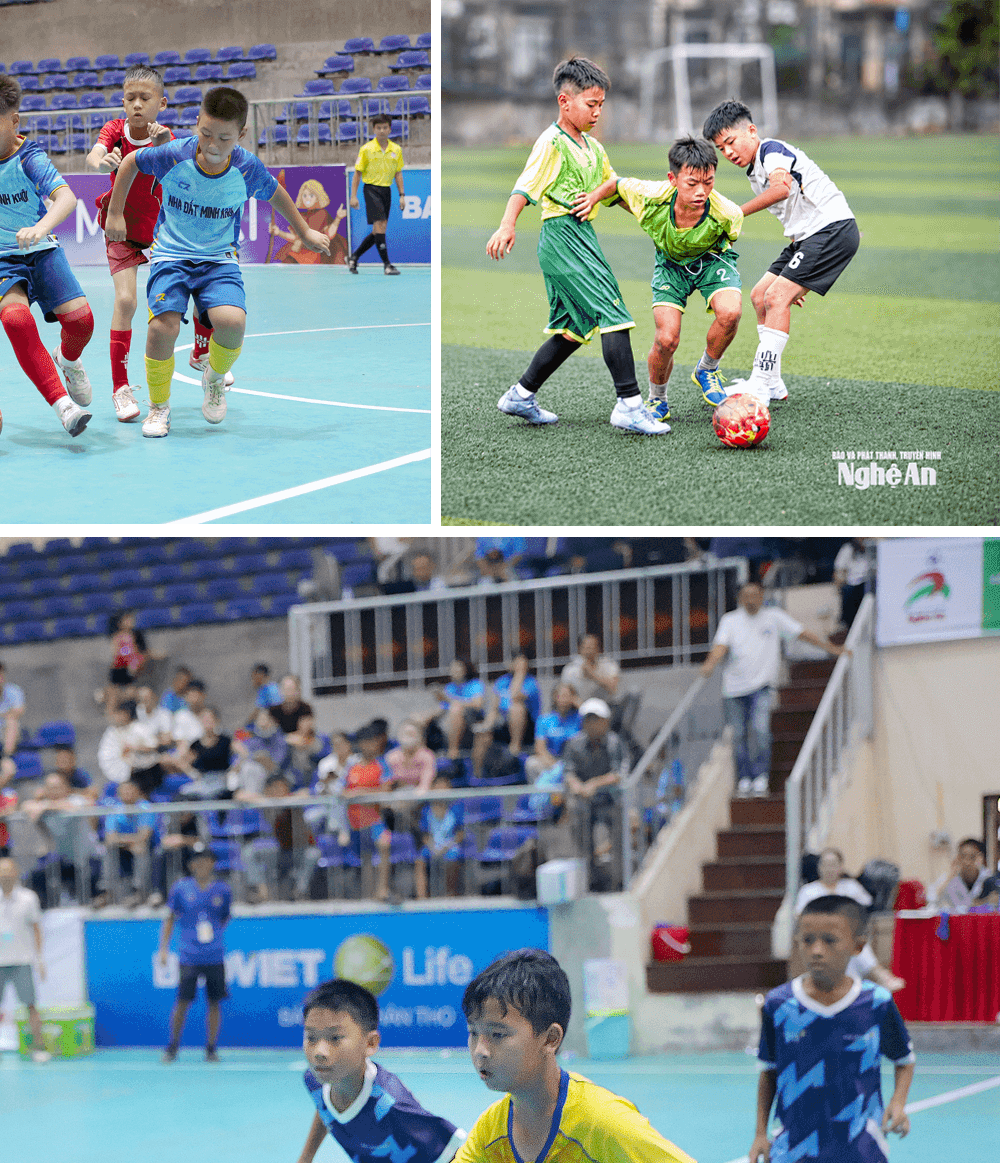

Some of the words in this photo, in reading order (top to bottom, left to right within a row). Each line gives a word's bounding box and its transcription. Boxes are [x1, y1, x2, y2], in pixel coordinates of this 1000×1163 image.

[788, 252, 805, 270] 6
[716, 268, 731, 282] 2
[402, 945, 474, 986] Life
